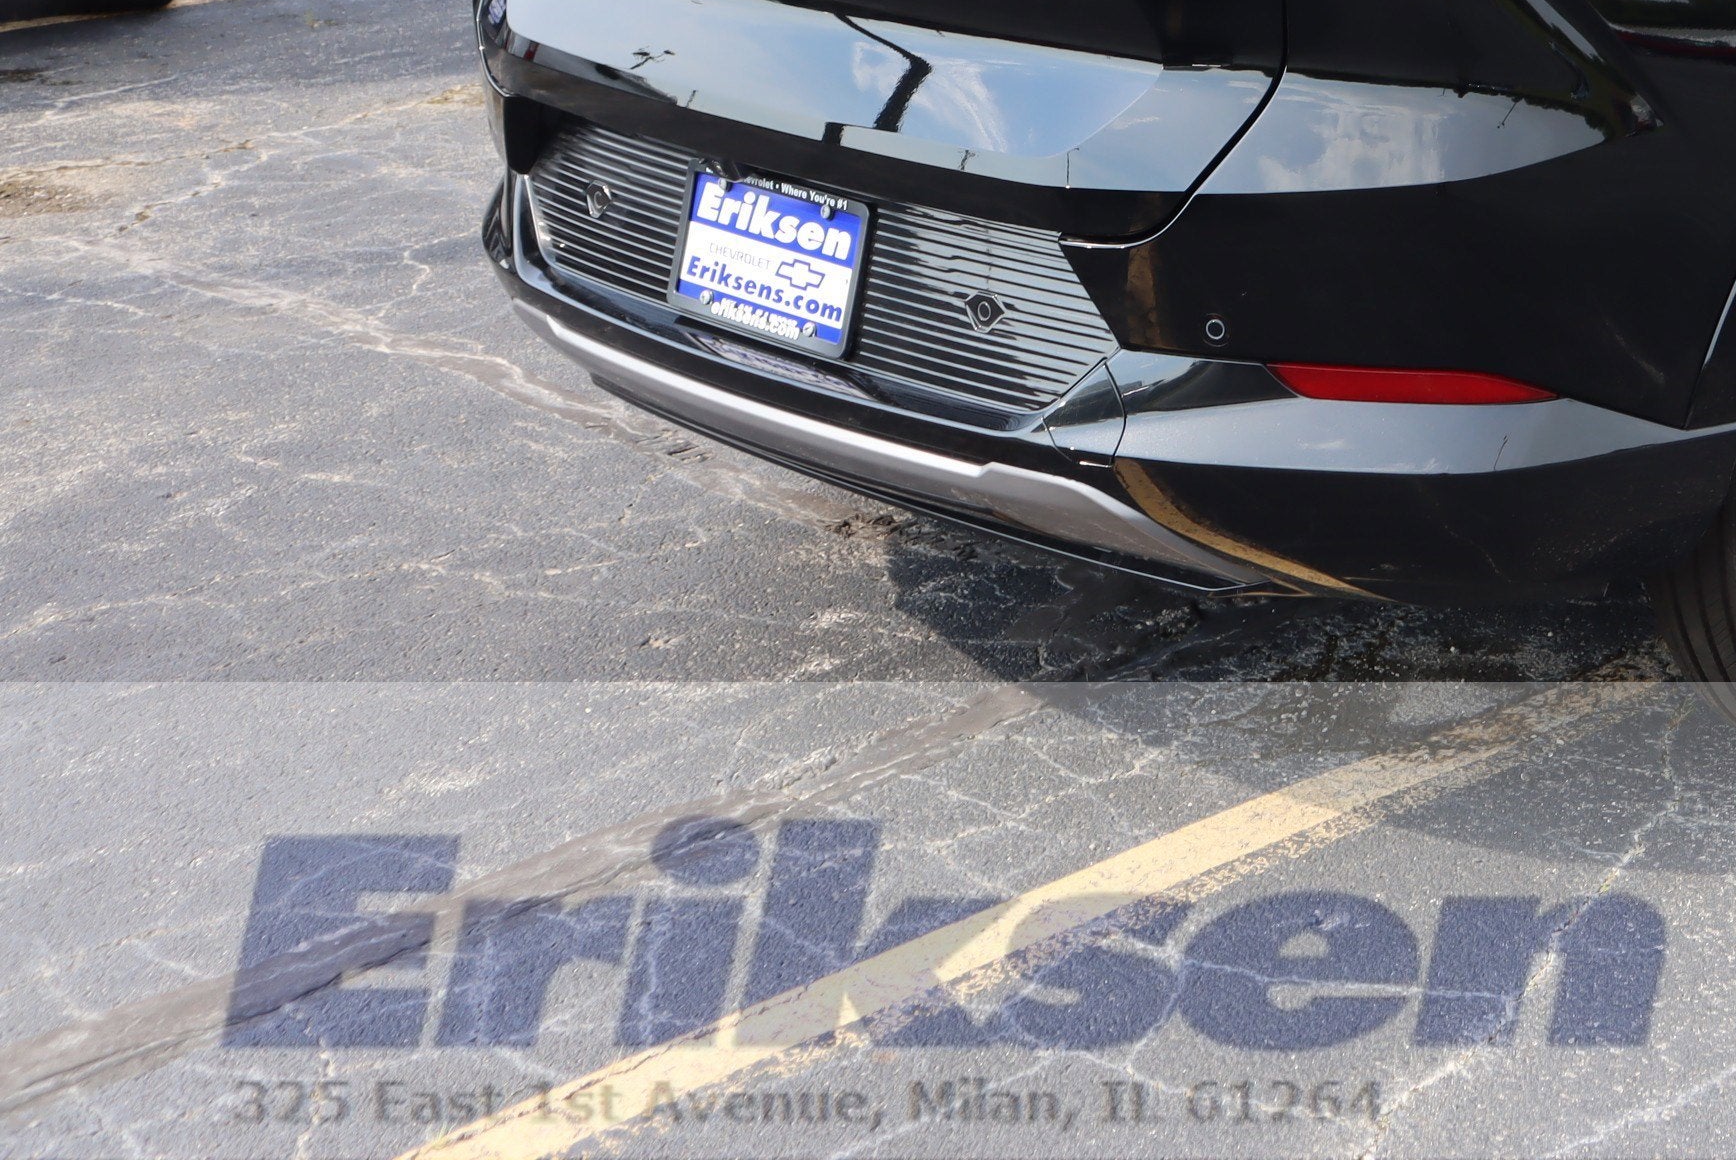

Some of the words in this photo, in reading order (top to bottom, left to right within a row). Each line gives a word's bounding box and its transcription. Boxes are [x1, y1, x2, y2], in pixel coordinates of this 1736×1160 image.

[696, 181, 852, 261] Eriksen
[780, 182, 807, 200] Where
[809, 190, 836, 208] You're
[836, 199, 848, 211] #1
[708, 241, 771, 271] CHEVROLET
[686, 255, 843, 323] Eriksens.com
